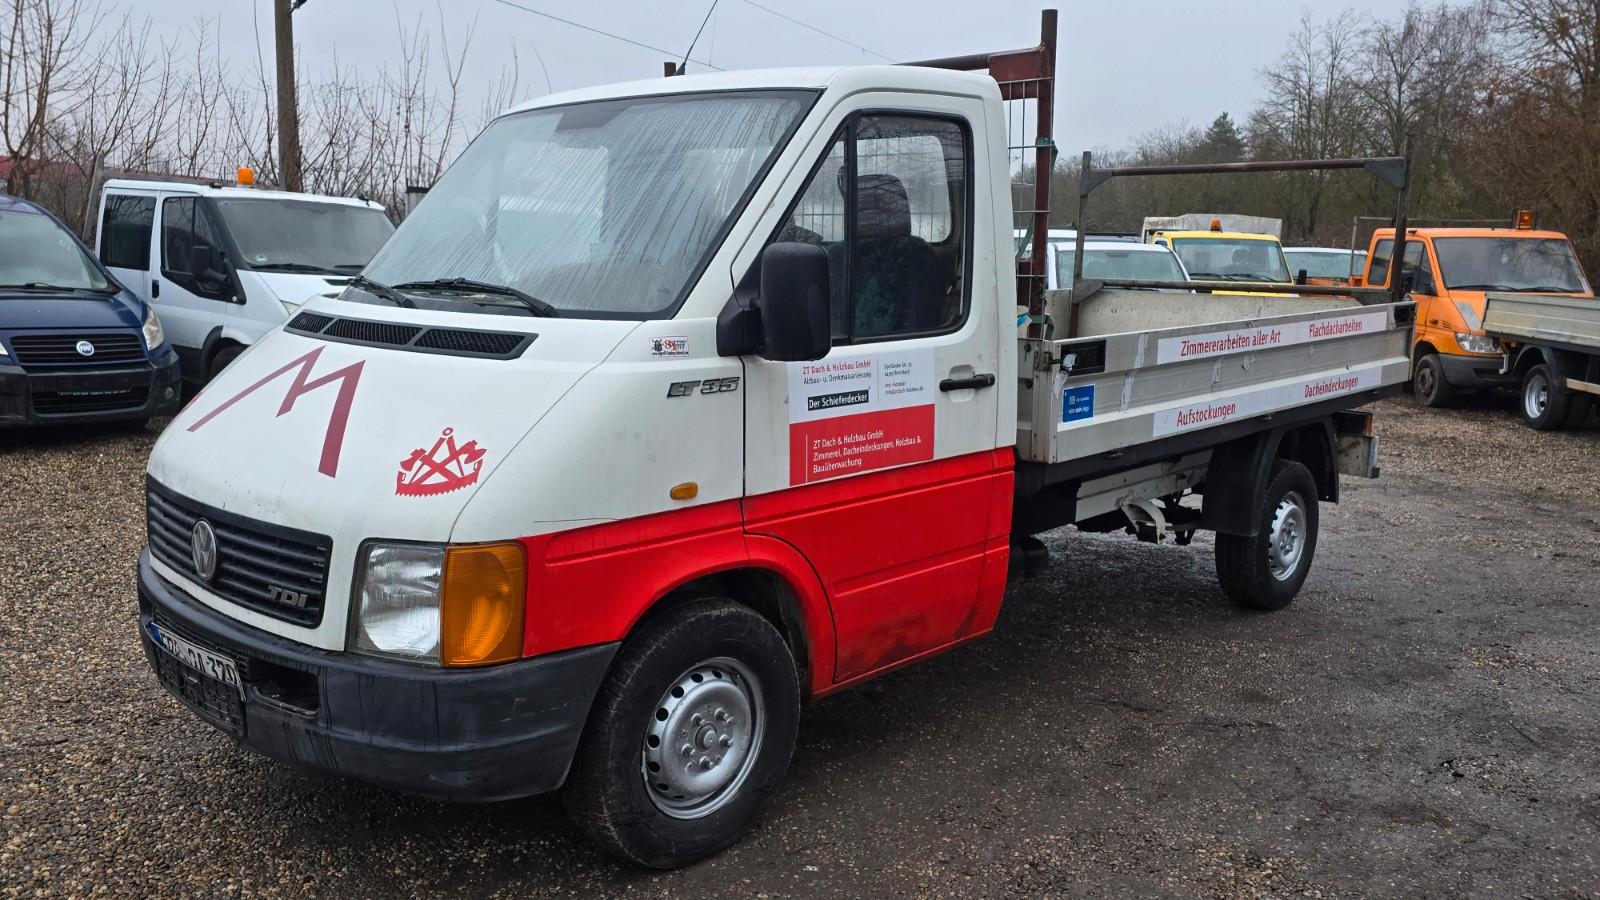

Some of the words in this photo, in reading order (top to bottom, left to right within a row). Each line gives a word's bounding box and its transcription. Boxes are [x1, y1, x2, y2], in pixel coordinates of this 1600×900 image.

[1309, 319, 1362, 338] Flachdacharbeiten
[1181, 333, 1250, 357] Zimmererarbeiten
[1251, 331, 1269, 347] aller
[1270, 329, 1281, 344] Art
[802, 366, 810, 374] ZT
[811, 364, 826, 374] Dach
[826, 364, 832, 372] &
[832, 361, 855, 372] Holzbau
[855, 360, 871, 369] GmbH
[701, 376, 740, 395] 35
[1304, 375, 1359, 398] Dacheindeckungen
[809, 399, 821, 409] Der
[821, 393, 868, 407] Schieferdecker
[1176, 402, 1236, 426] Aufstockungen
[813, 440, 821, 450] ZT
[822, 437, 837, 448] Dach
[837, 436, 843, 445] &
[843, 432, 867, 443] Holzbau
[867, 429, 884, 440] GmbH
[895, 438, 916, 447] Holzbau
[916, 435, 922, 443] &
[813, 458, 862, 474] Bauüberwachung
[267, 584, 309, 608] TDI
